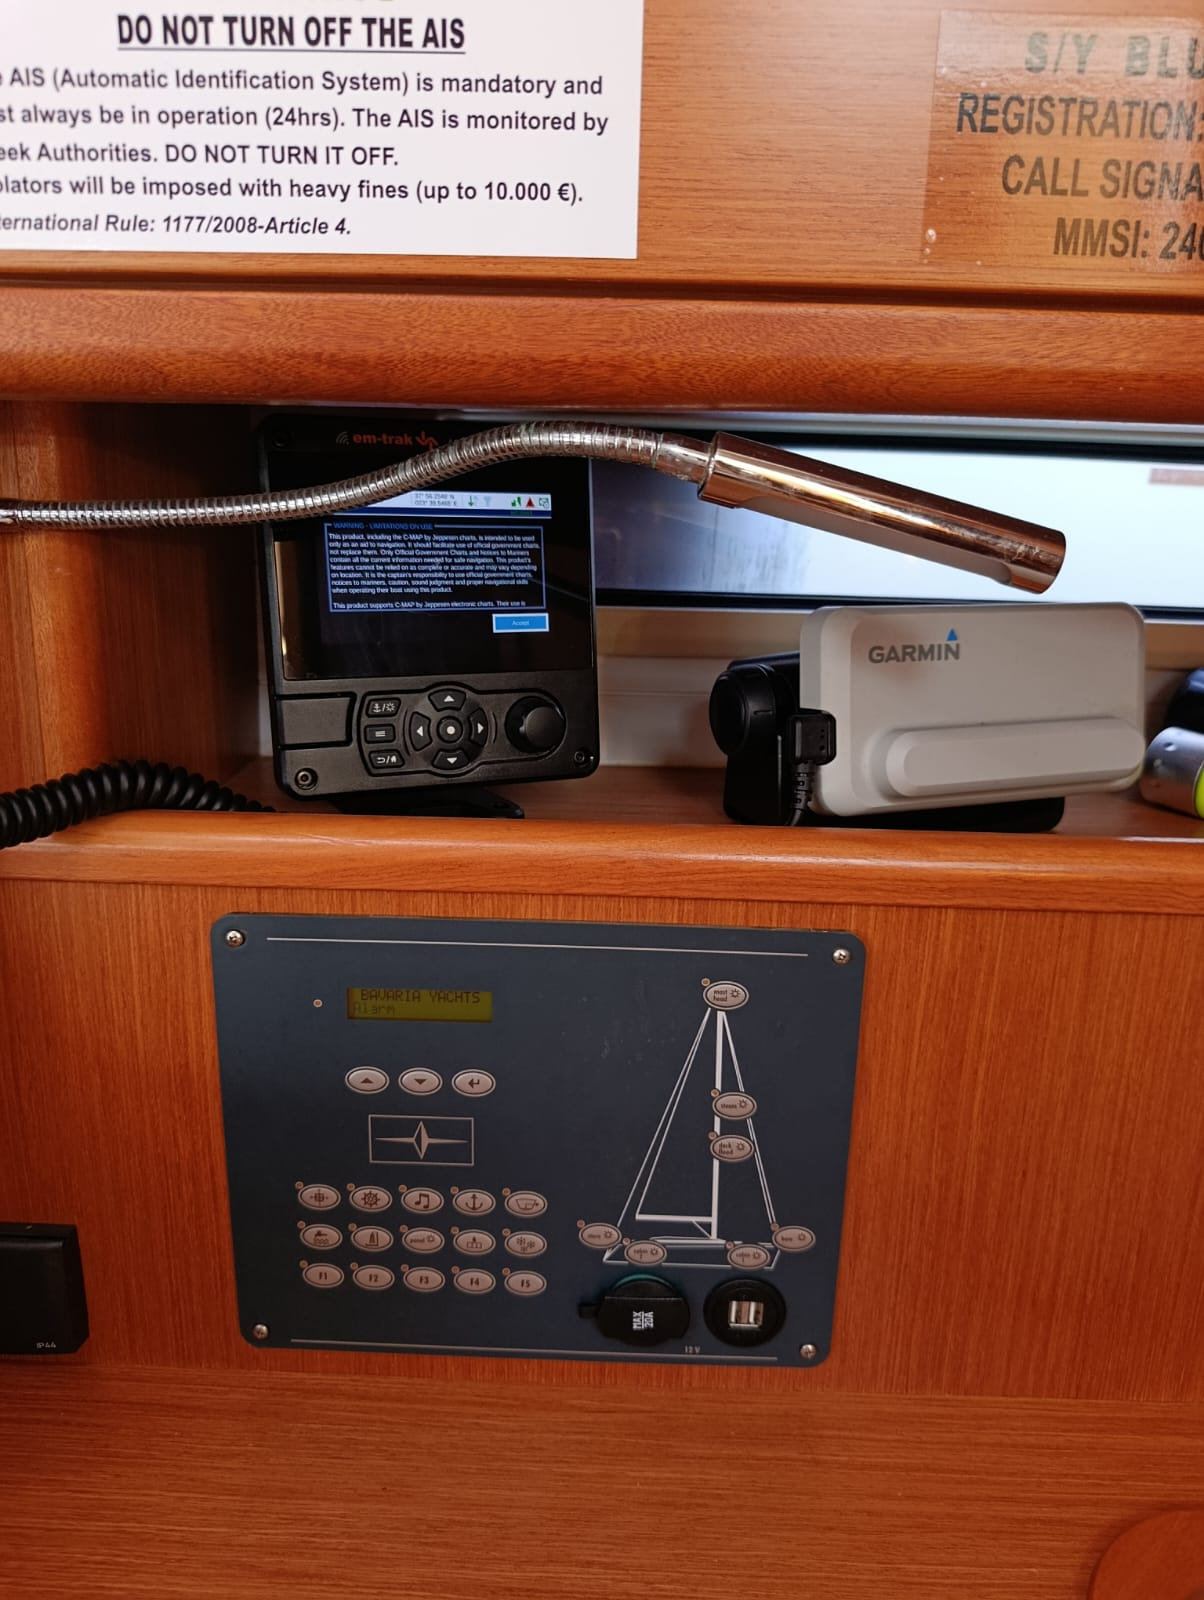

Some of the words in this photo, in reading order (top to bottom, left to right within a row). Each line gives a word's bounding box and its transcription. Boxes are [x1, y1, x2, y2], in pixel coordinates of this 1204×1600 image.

[117, 14, 152, 45] DO
[162, 15, 214, 45] NOT
[223, 16, 294, 46] TURN
[304, 16, 352, 47] OFF
[361, 17, 413, 48] THE
[422, 18, 464, 49] AIS
[1024, 31, 1098, 74] S/Y
[10, 68, 45, 87] AIS
[53, 69, 168, 91] (Automatic
[176, 69, 314, 90] Identification
[322, 71, 408, 96] System)
[417, 72, 434, 92] is
[442, 74, 556, 99] mandatory
[564, 76, 602, 95] and
[22, 104, 92, 128] always
[100, 105, 124, 124] be
[132, 105, 149, 124] in
[158, 106, 257, 128] operation
[266, 107, 344, 131] (24hrs).
[352, 108, 391, 127] The
[398, 109, 434, 128] AIS
[442, 109, 459, 128] is
[467, 111, 575, 130] monitored
[584, 112, 608, 136] by
[37, 143, 157, 162] Authorities.
[165, 144, 197, 163] DO
[205, 144, 250, 163] NOT
[257, 145, 317, 164] TURN
[326, 146, 344, 165] IT
[352, 146, 398, 166] OFF.
[1001, 154, 1089, 198] CALL
[69, 176, 103, 194] will
[111, 176, 135, 195] be
[143, 177, 231, 200] imposed
[238, 178, 282, 197] with
[290, 179, 351, 203] heavy
[358, 179, 408, 198] fines
[417, 180, 449, 204] (up
[456, 182, 477, 200] to
[485, 182, 551, 201] 10.000
[557, 183, 582, 206] €).
[105, 214, 155, 232] Rule:
[163, 216, 328, 234] 1177/2008-Article
[335, 217, 350, 234] 4.
[1053, 216, 1150, 259] MMSI:
[1159, 220, 1204, 262] 24
[352, 433, 412, 445] em-trak
[868, 643, 960, 664] GARMIN
[361, 989, 421, 1003] BAVARIA
[429, 990, 480, 1004] YACHTS
[353, 1002, 395, 1015] Alarm
[319, 1271, 328, 1280] F1
[369, 1273, 378, 1282] F2
[419, 1275, 429, 1284] F3
[470, 1277, 480, 1286] F4
[520, 1279, 531, 1288] F5
[632, 1311, 642, 1329] MAX
[644, 1311, 654, 1329] 20A
